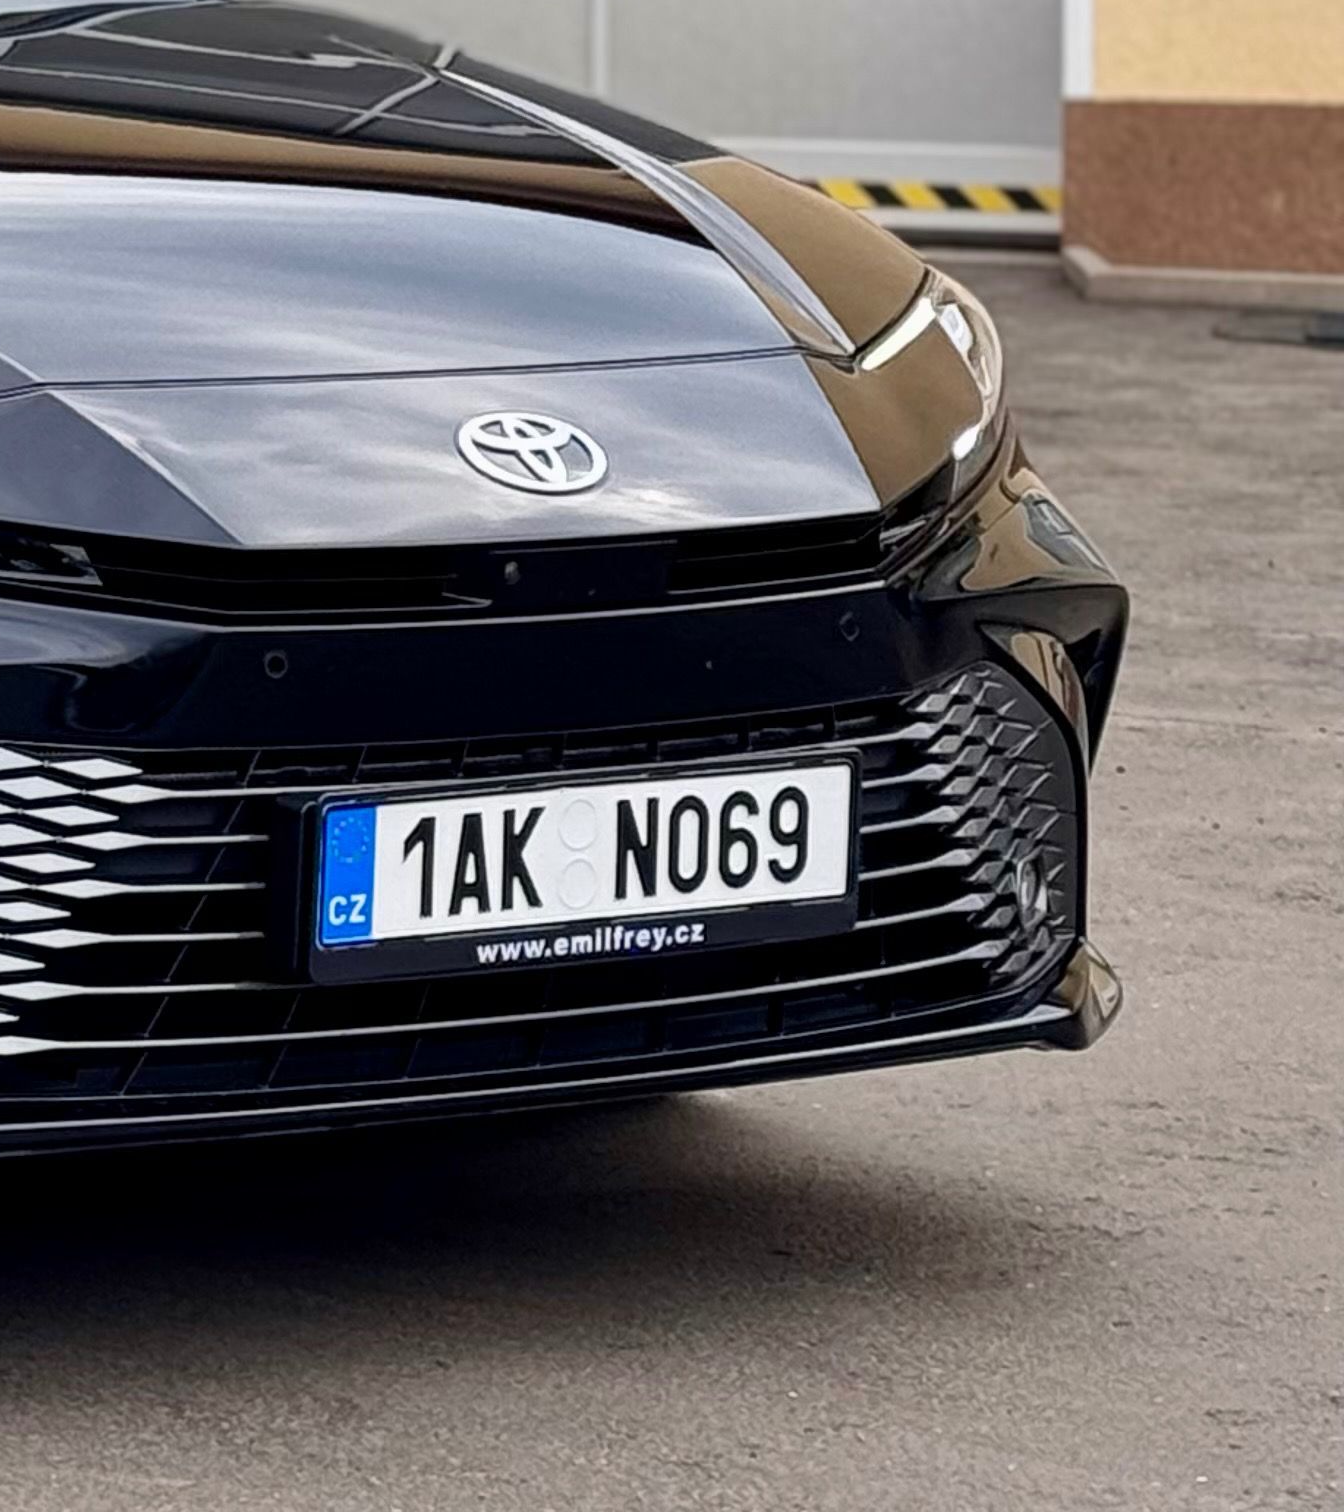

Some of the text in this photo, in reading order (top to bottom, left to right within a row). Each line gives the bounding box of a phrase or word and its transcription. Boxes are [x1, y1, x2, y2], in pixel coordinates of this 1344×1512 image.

[402, 786, 810, 918] 1AK N069
[328, 893, 367, 926] CZ
[476, 923, 706, 964] www.emilfrey.cz
